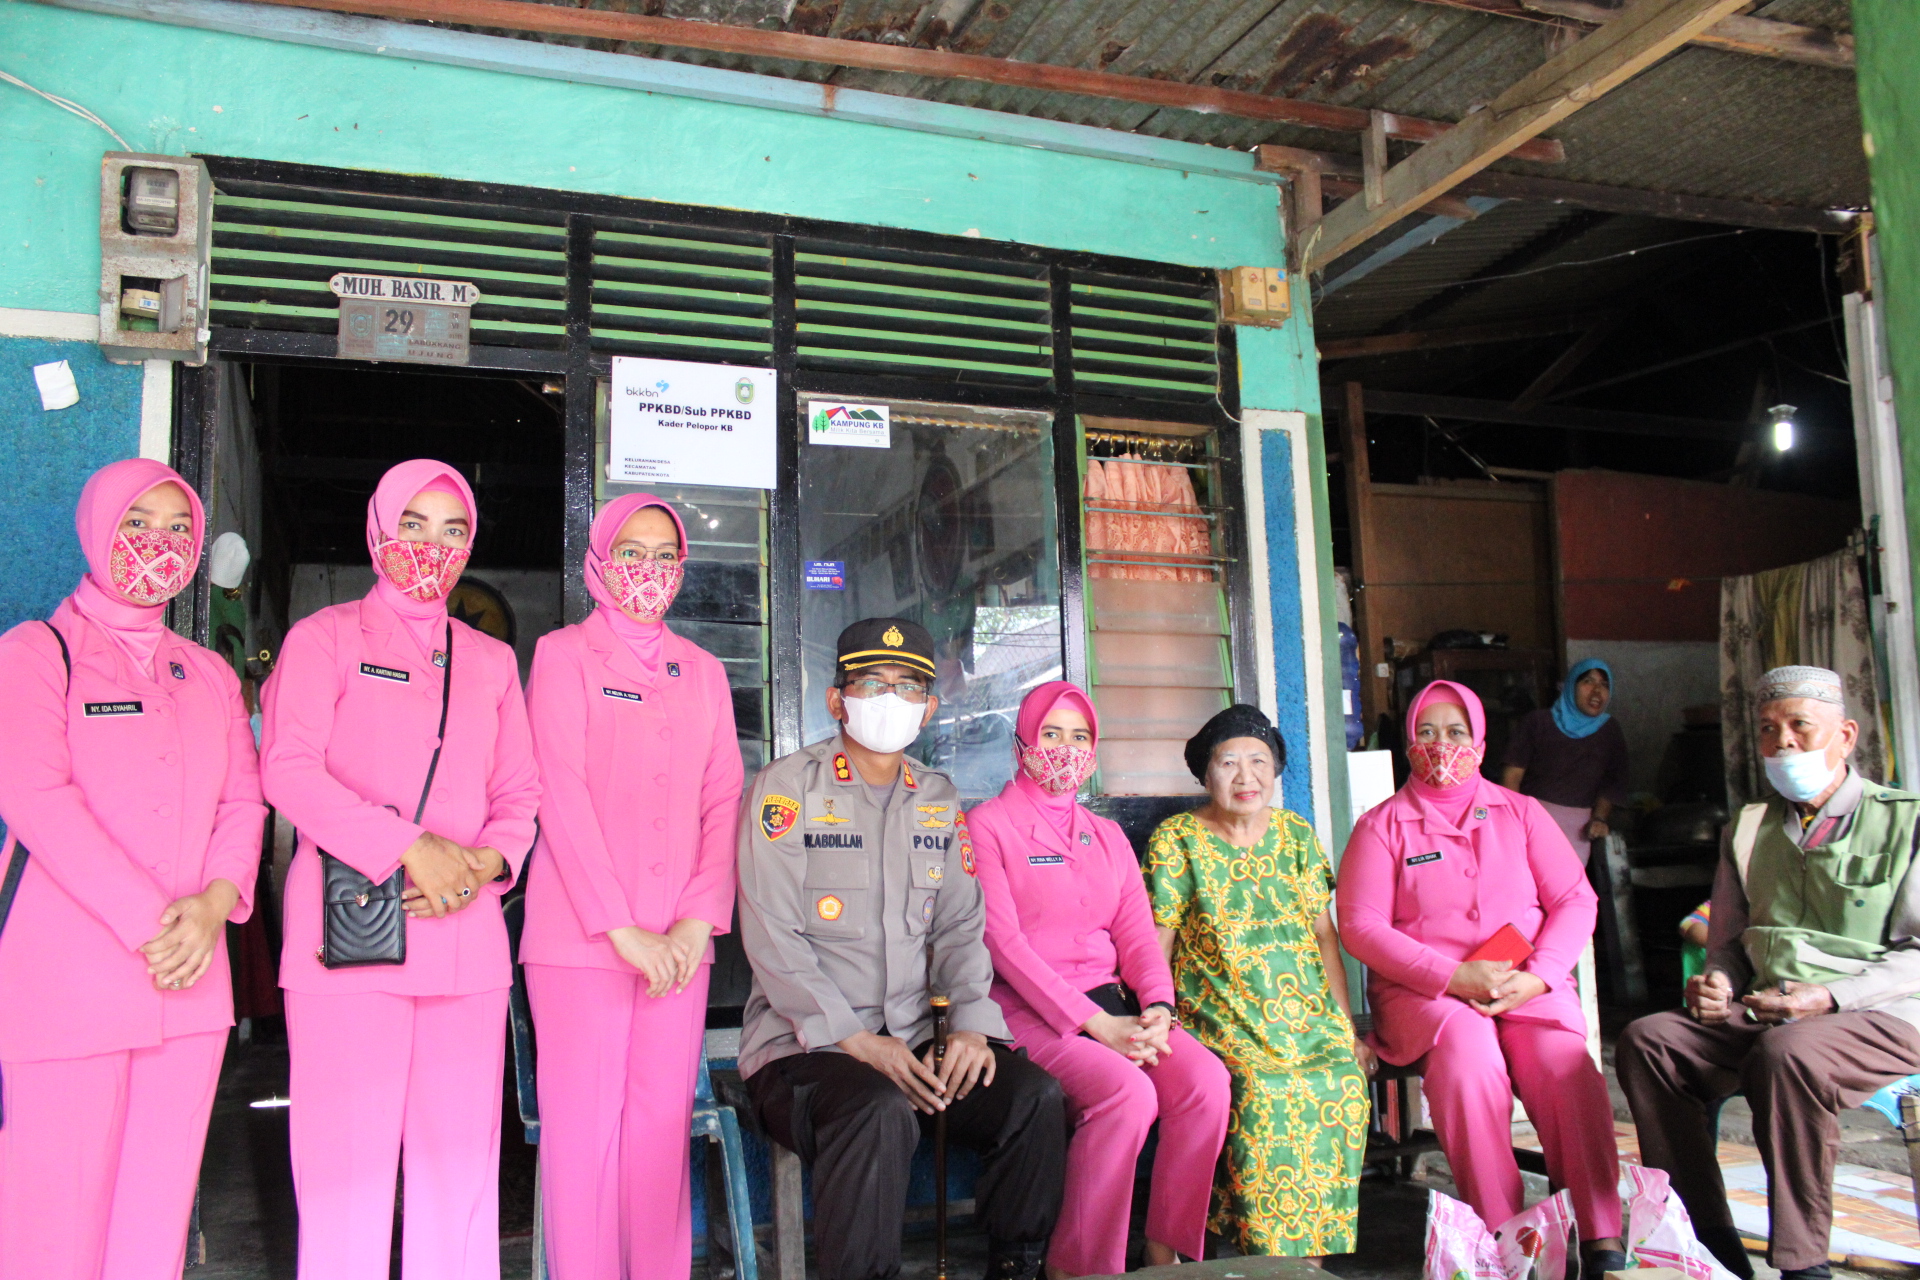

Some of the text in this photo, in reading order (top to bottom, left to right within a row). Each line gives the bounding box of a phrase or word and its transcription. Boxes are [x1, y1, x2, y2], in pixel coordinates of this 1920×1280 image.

[342, 276, 468, 302] MUH. BASIR. M
[384, 309, 414, 334] 29
[626, 386, 659, 398] bkkbn
[639, 402, 752, 420] PPKBD/Sub PPKBD
[658, 419, 733, 432] Kader Pelopor KB
[830, 420, 870, 428] KAMPUNG
[113, 704, 138, 712] SYAHRIL
[804, 833, 863, 849] W.ABDILLAH
